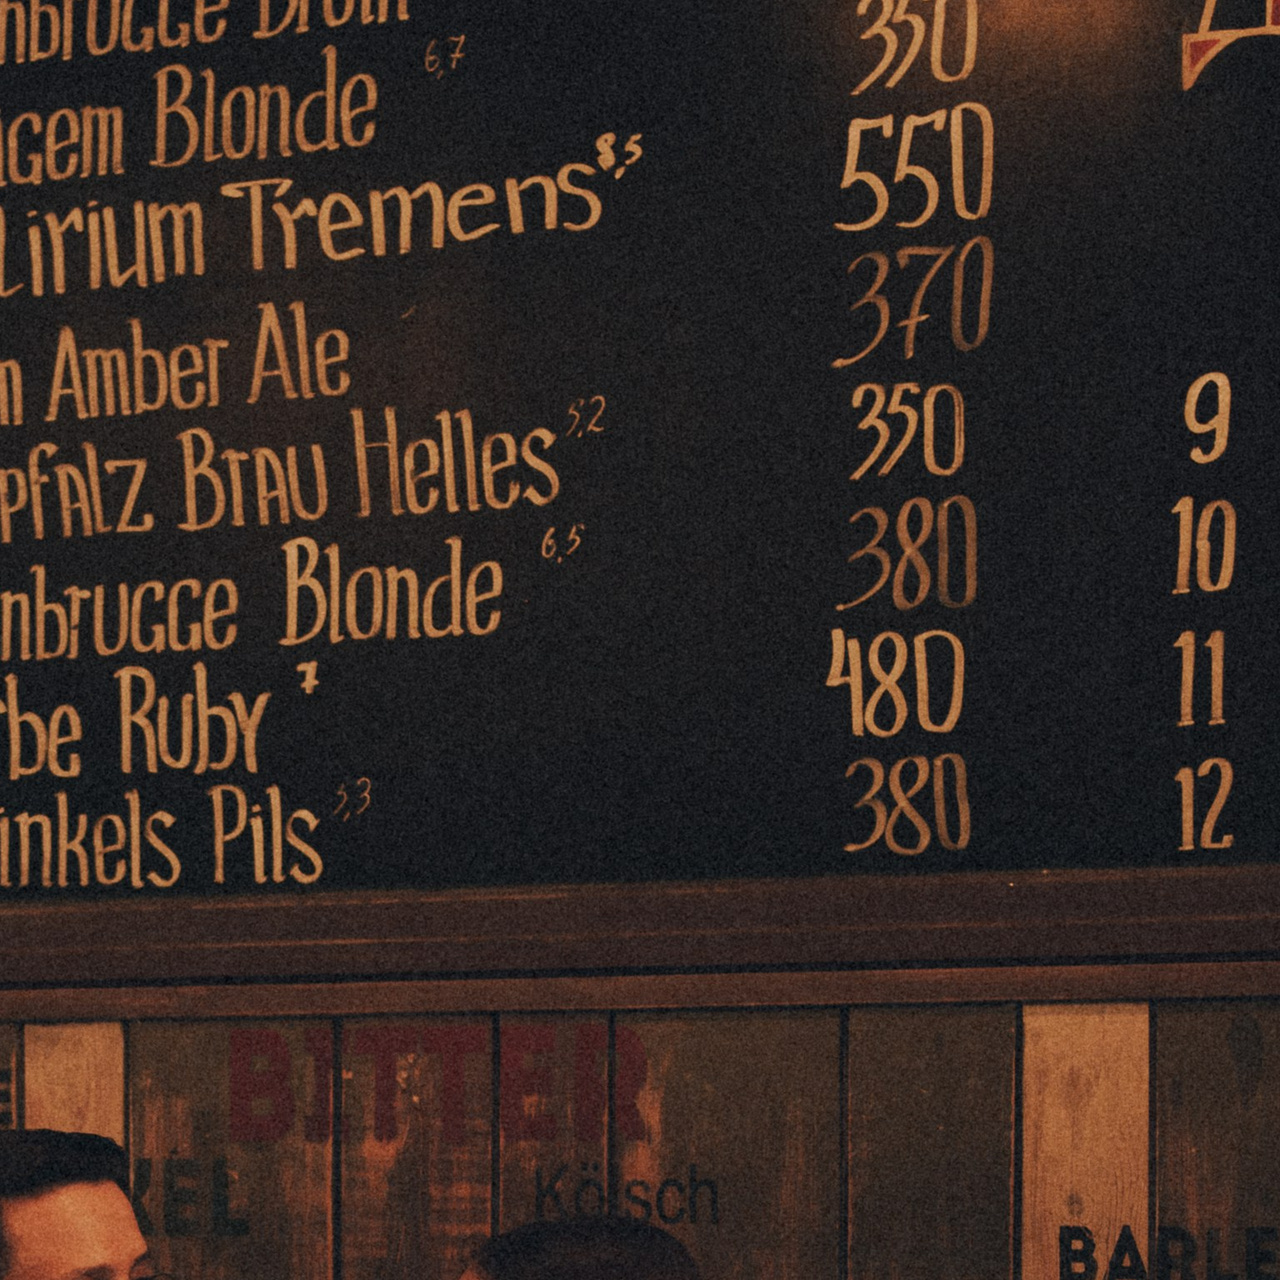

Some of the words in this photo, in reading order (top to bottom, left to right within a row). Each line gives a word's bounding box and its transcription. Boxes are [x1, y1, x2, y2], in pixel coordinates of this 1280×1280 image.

[848, 0, 980, 96] 350
[148, 43, 379, 169] Blonde
[218, 162, 603, 271] Tremens
[833, 101, 995, 232] 550
[830, 235, 995, 370] 370
[44, 317, 230, 423] Amber
[246, 300, 352, 405] Ale
[175, 426, 329, 533] Brau
[348, 405, 561, 518] Helles
[848, 381, 966, 482] 350
[1183, 371, 1233, 465] 9
[277, 535, 505, 647] Blonde
[834, 494, 979, 612] 380
[1170, 495, 1238, 596] 10
[112, 660, 273, 776] Ruby
[824, 627, 967, 738] 480
[1172, 629, 1227, 728] 11
[207, 784, 325, 885] Pils
[843, 752, 972, 856] 380
[1173, 756, 1235, 852] 12
[230, 1023, 648, 1142] BITTER
